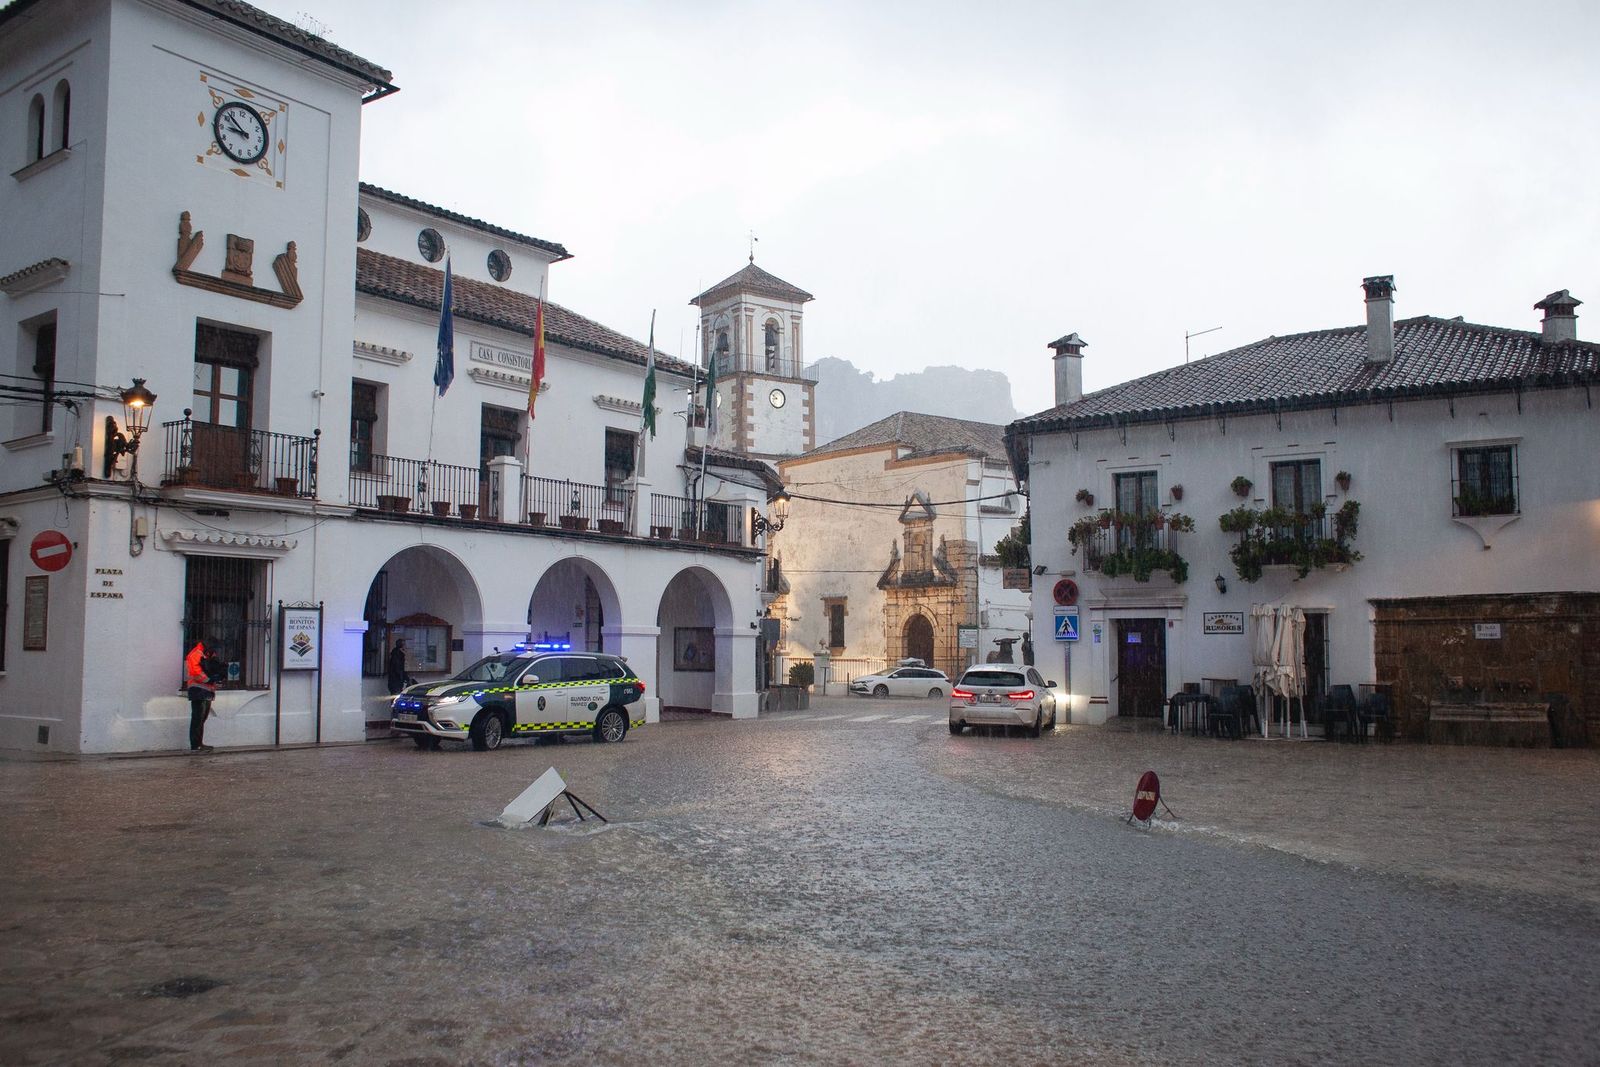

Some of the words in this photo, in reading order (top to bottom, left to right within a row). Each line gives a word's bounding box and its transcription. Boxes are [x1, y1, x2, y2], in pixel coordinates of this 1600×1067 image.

[240, 110, 246, 118] 12
[478, 347, 493, 361] CASA
[498, 351, 531, 370] CONSISTORI
